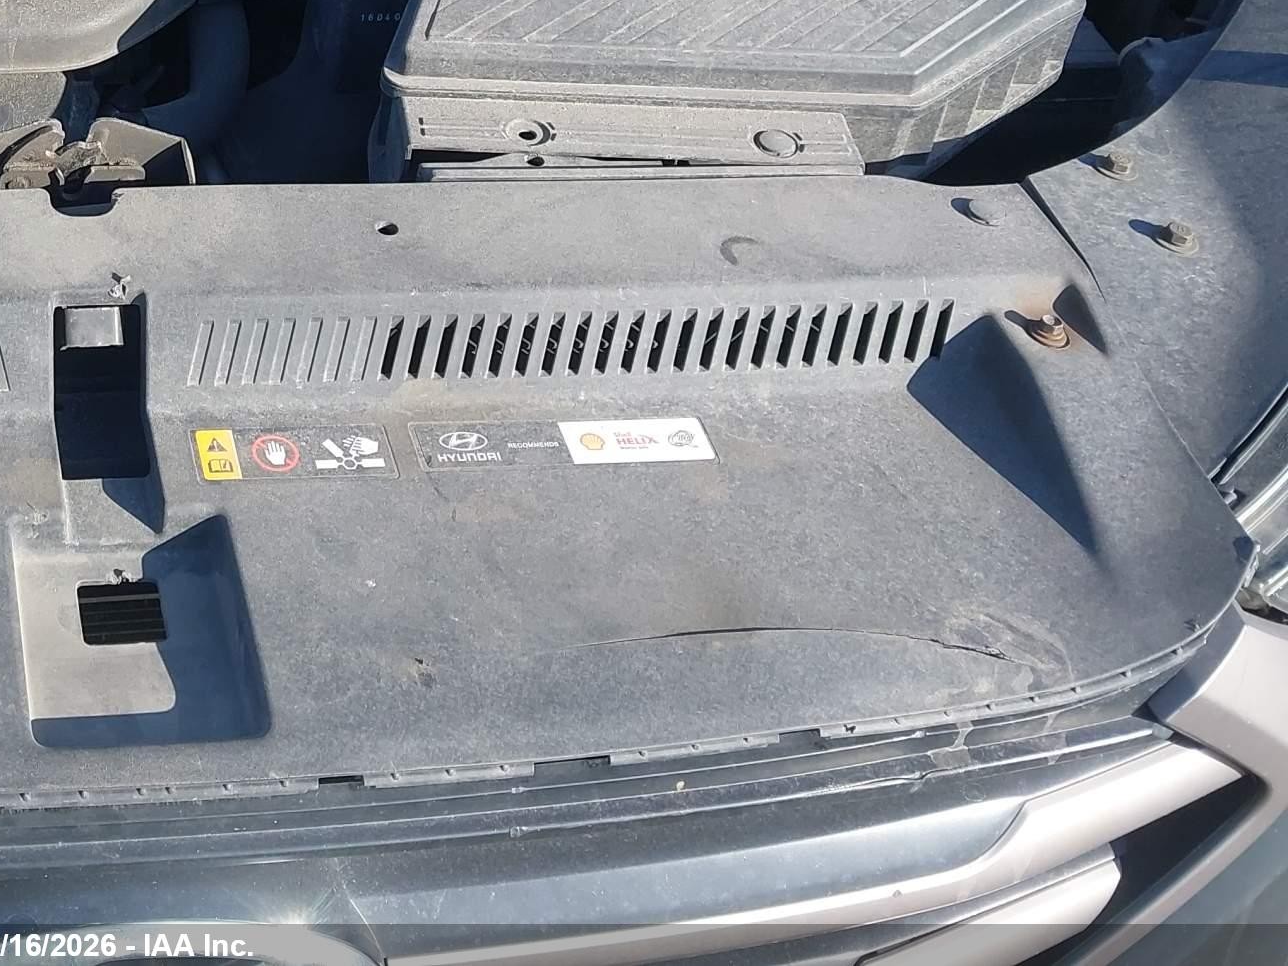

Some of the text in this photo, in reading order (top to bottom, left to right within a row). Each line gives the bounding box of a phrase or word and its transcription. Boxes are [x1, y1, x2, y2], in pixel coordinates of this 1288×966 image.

[615, 435, 660, 445] HELIX
[437, 440, 560, 463] HYUNDAI RECOMMENDS
